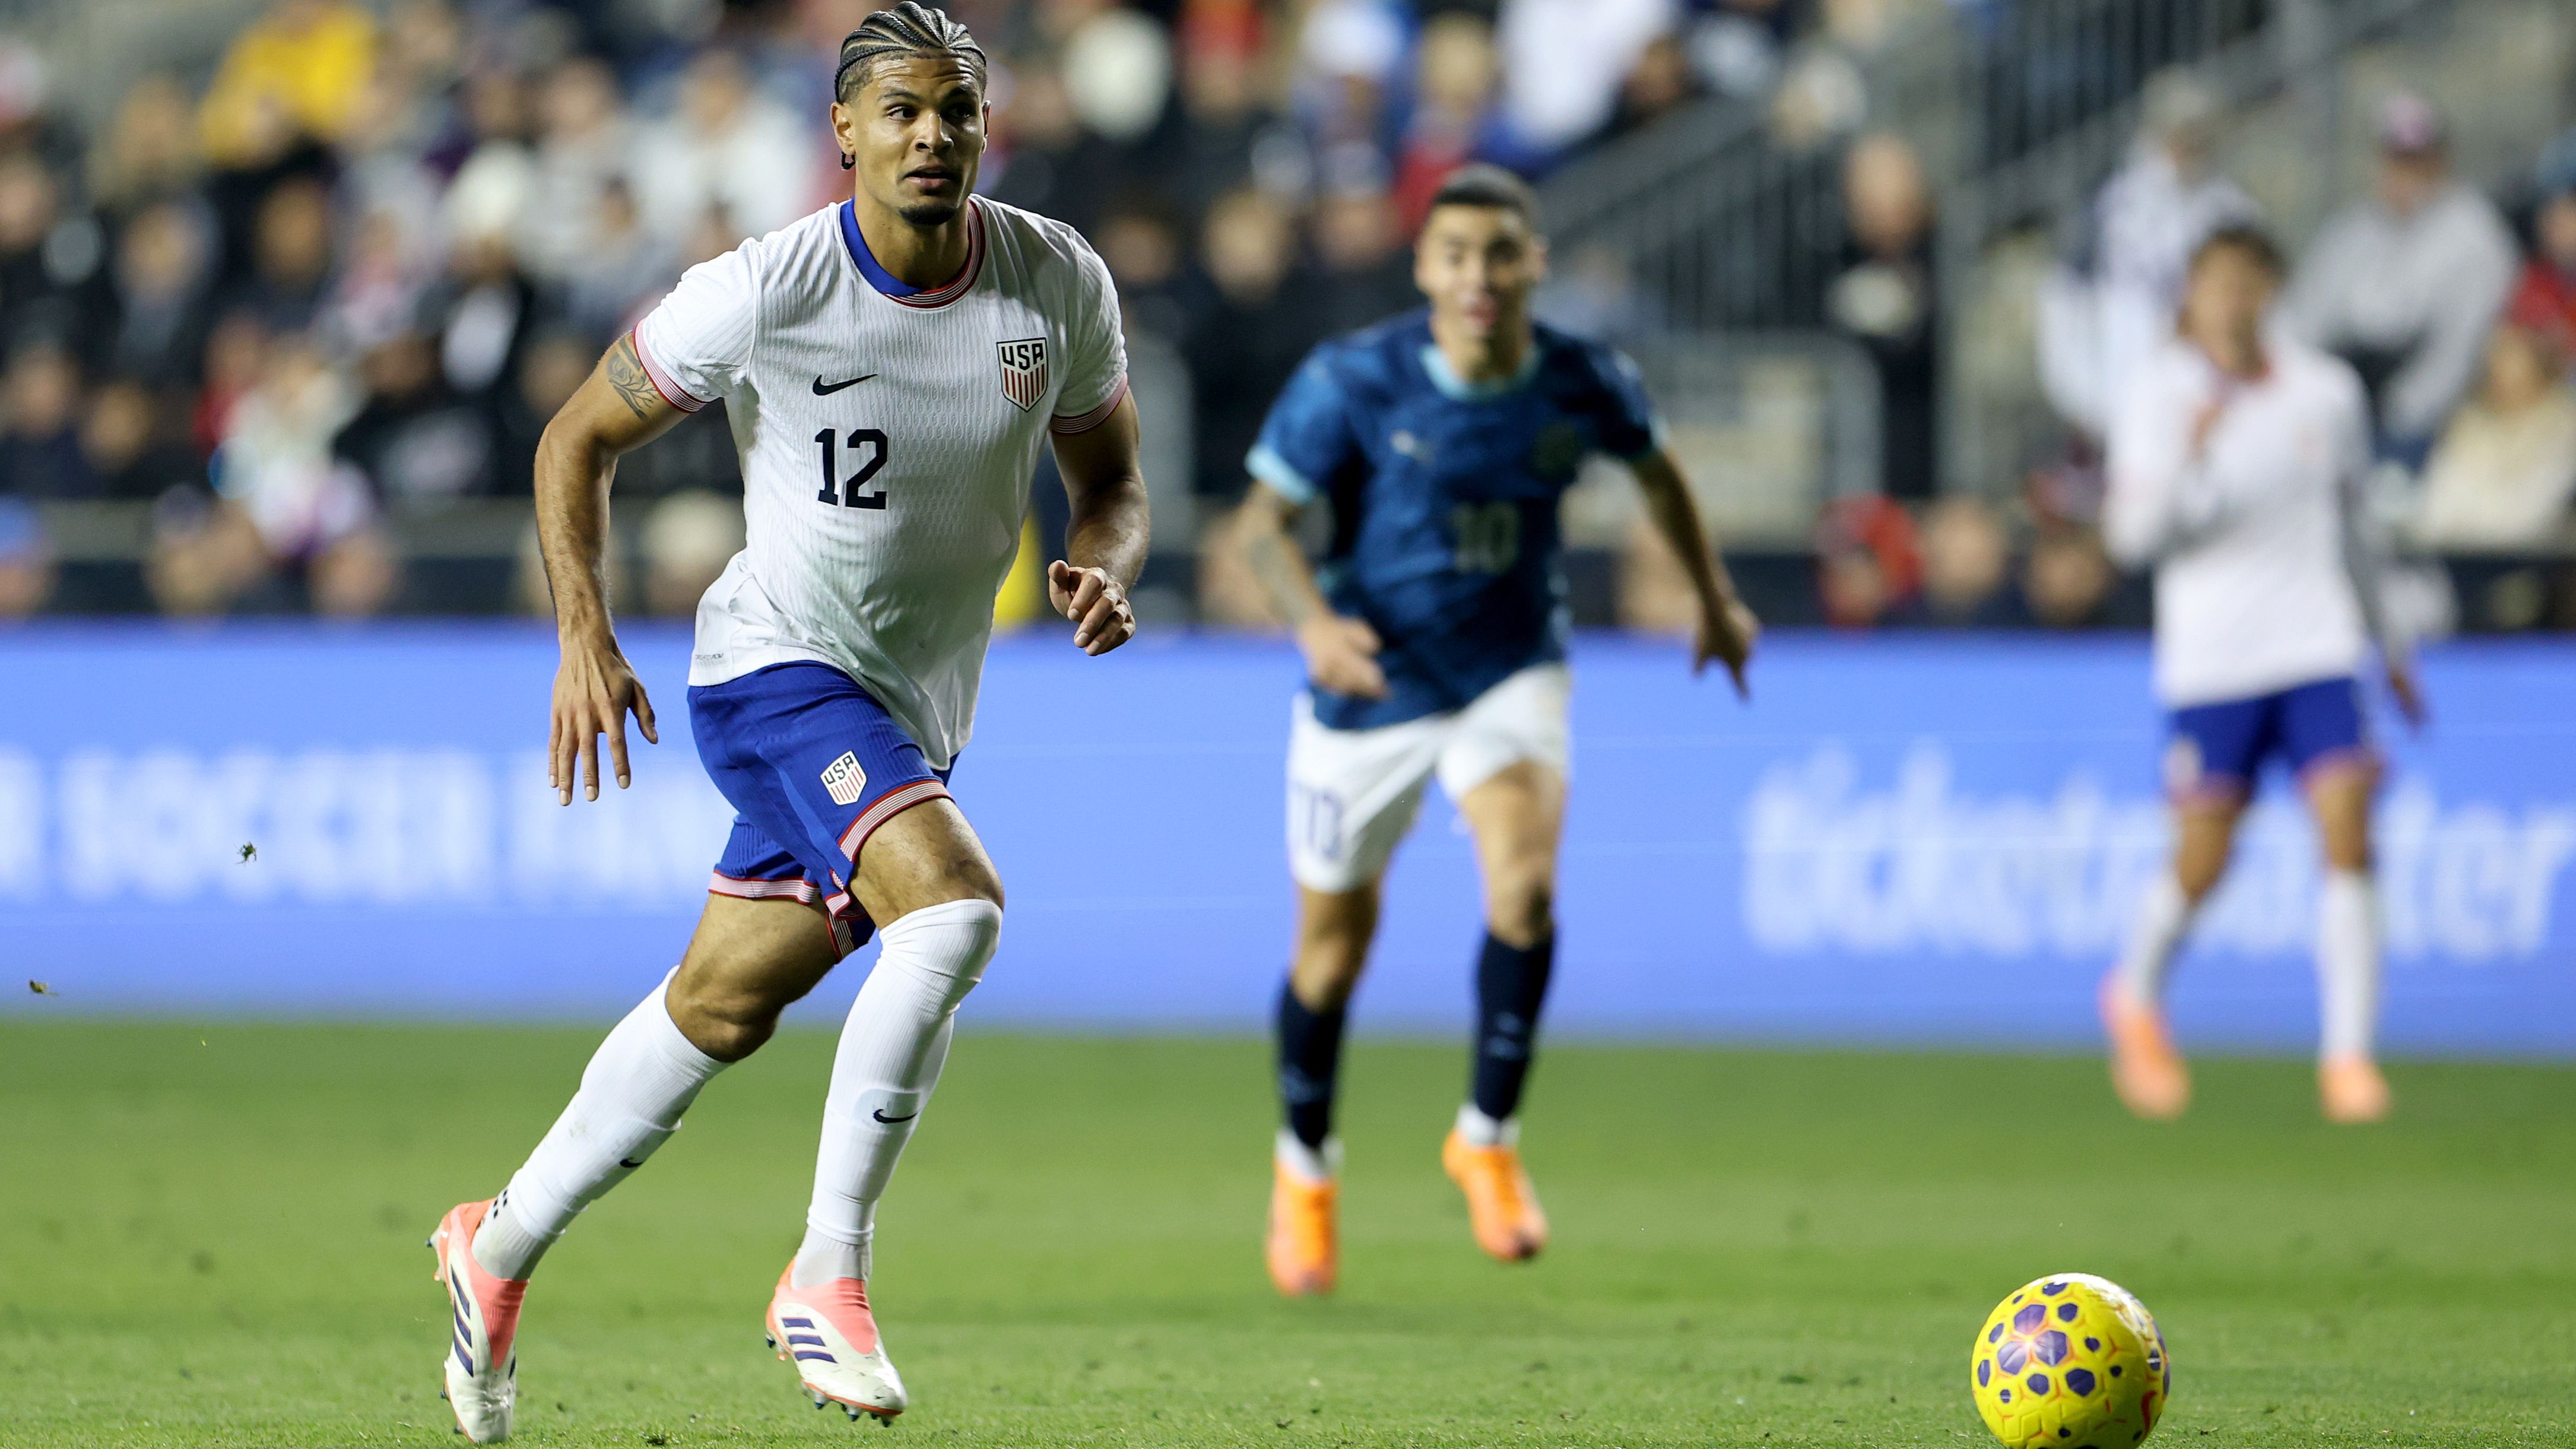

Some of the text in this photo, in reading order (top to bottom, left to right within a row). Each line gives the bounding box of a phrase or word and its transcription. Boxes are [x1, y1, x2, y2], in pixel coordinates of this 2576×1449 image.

[1001, 343, 1045, 371] USA
[814, 427, 889, 511] 12
[1450, 502, 1522, 575] 10
[824, 754, 854, 785] USA
